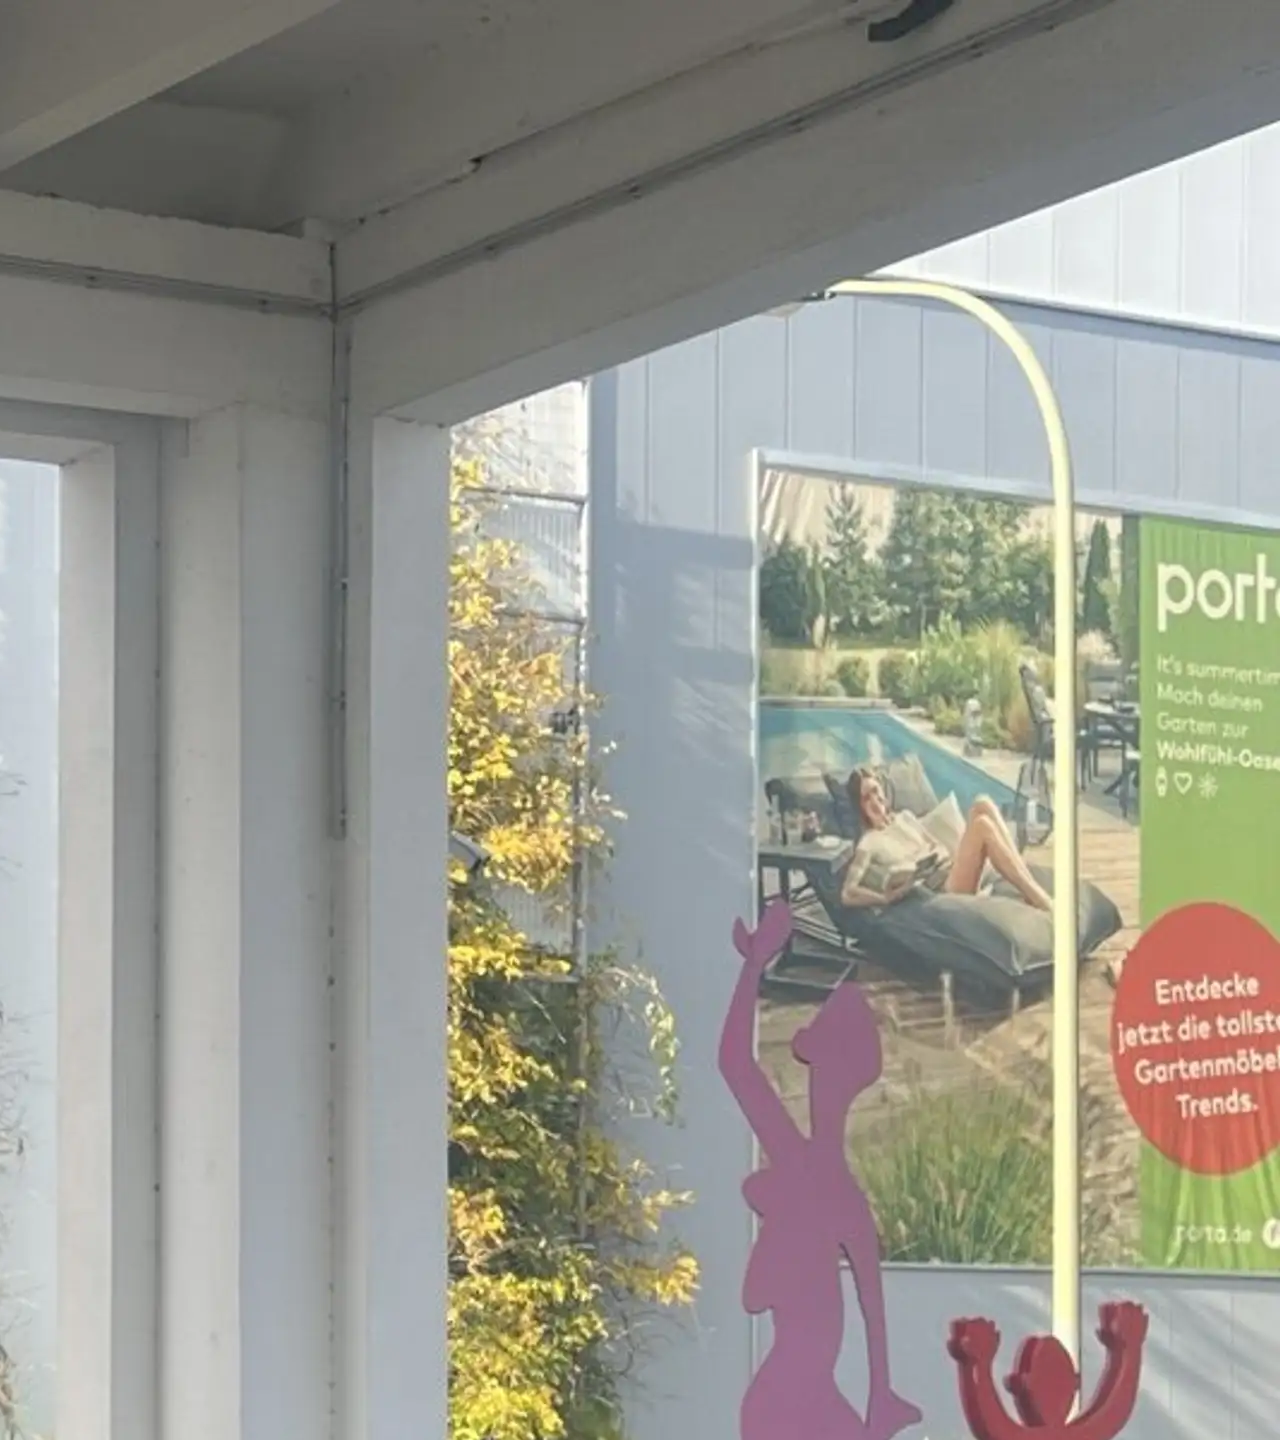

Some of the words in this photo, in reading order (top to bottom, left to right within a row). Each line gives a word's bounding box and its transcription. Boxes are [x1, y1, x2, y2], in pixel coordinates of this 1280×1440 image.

[1157, 553, 1280, 633] port
[1156, 682, 1203, 706] Mach
[1207, 688, 1263, 712] deinen
[1156, 711, 1217, 735] Garten
[1221, 722, 1249, 739] zur
[1155, 972, 1259, 1005] Entdecke
[1117, 1021, 1173, 1055] jetzt
[1177, 1013, 1211, 1042] die
[1175, 1086, 1259, 1119] Trends.
